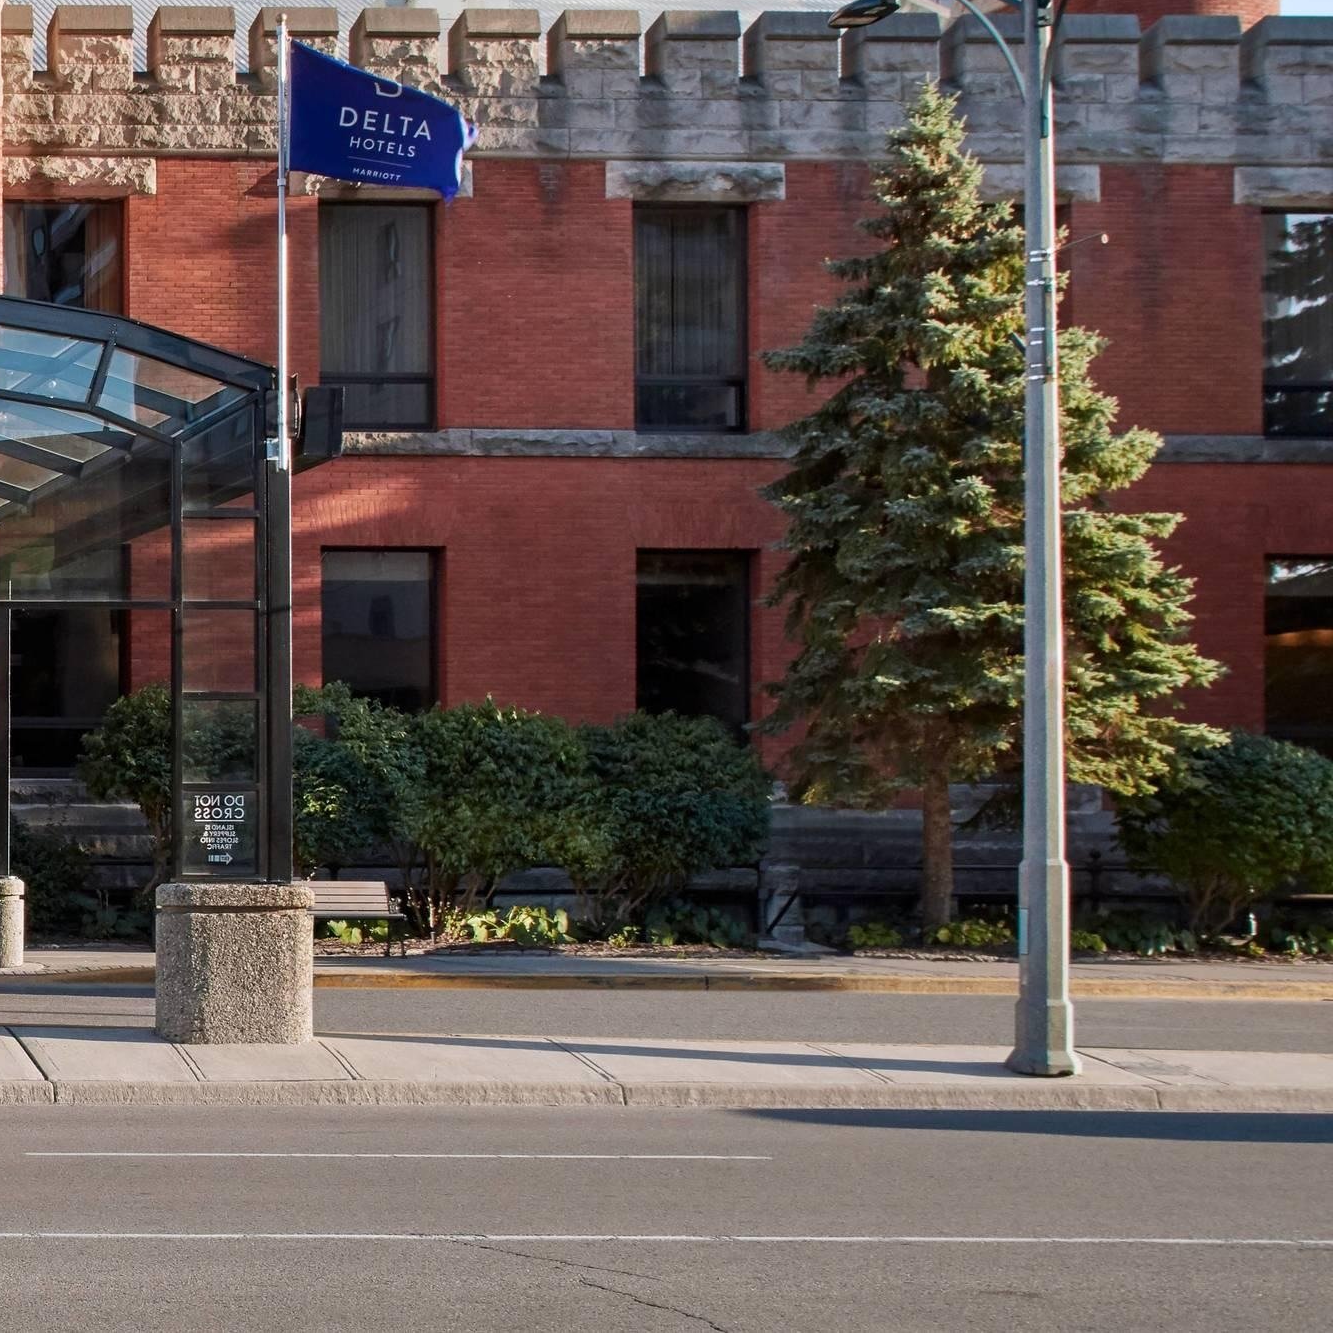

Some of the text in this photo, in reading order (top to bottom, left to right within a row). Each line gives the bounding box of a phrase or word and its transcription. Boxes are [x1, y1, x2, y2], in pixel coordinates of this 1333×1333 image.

[339, 106, 431, 141] DELTA
[349, 136, 416, 157] HOTELS
[352, 168, 401, 181] MARRIOTT
